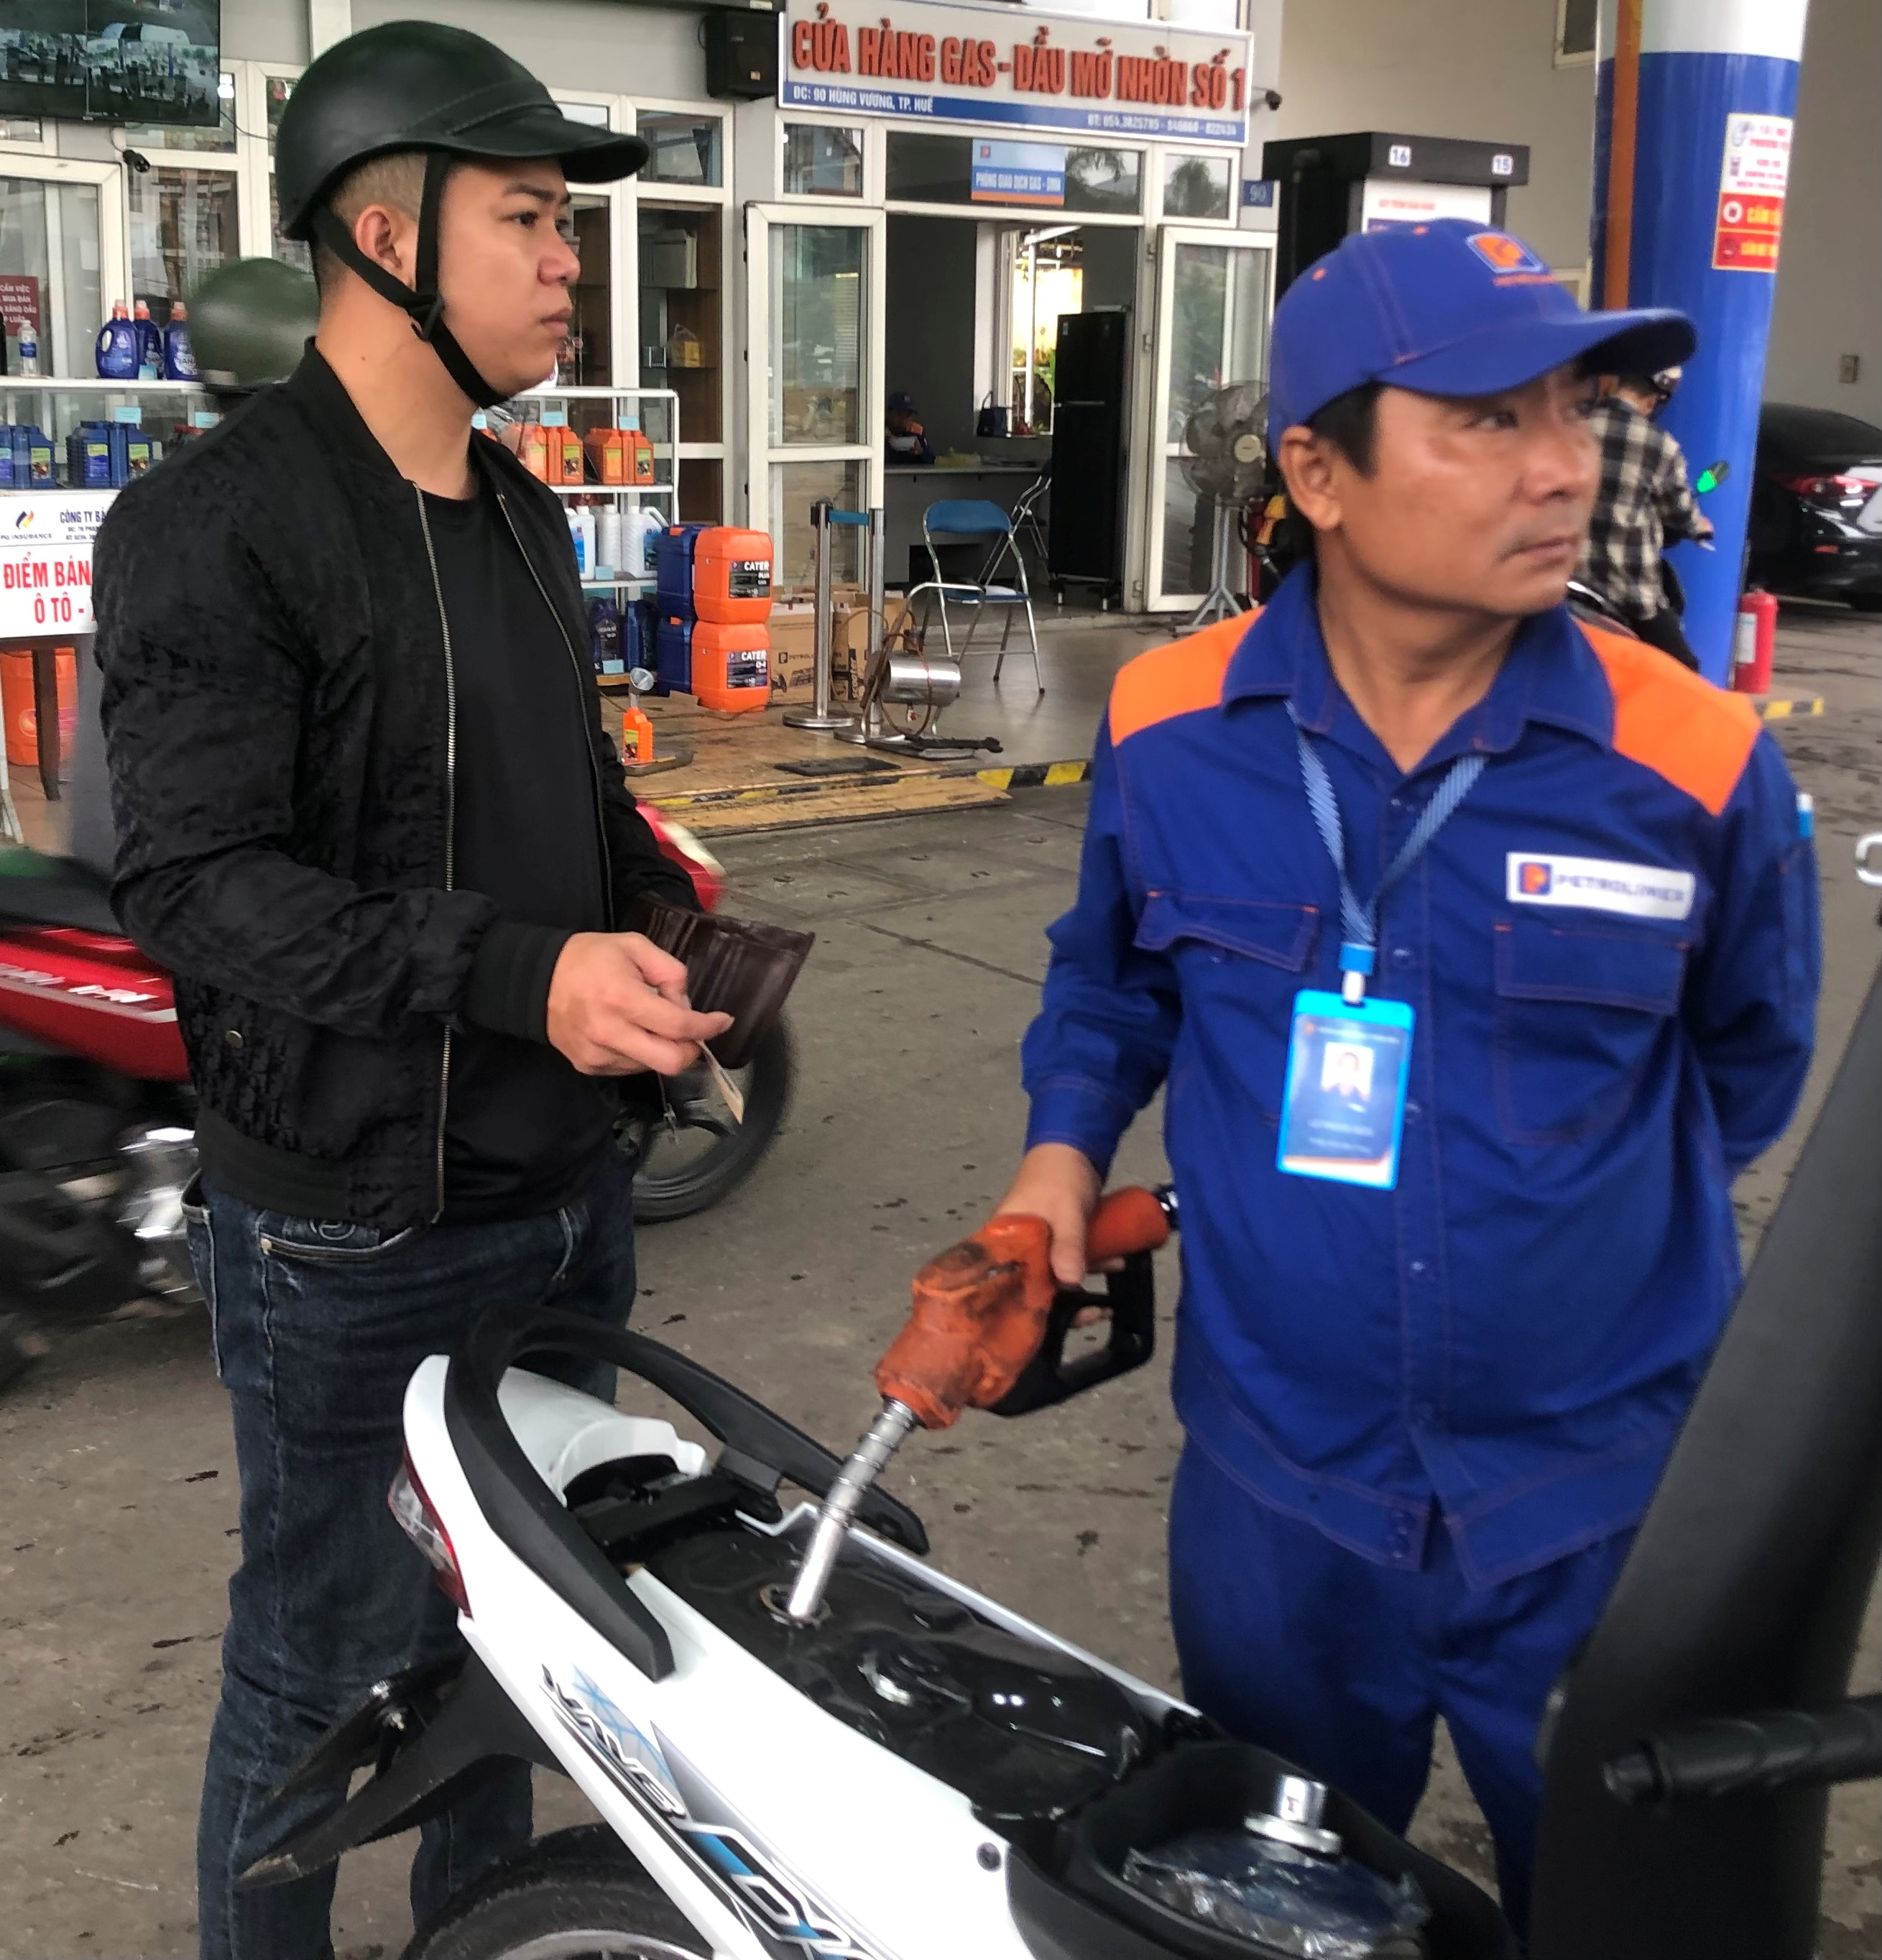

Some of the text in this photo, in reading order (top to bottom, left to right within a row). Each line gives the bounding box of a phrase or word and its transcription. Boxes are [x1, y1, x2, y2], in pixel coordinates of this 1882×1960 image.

[792, 2, 851, 73] CỬA
[858, 17, 935, 81] HÀNG
[1071, 37, 1113, 98] MỠ
[1116, 45, 1188, 106] NHỜN
[1192, 47, 1231, 109] SỐ
[1230, 68, 1245, 111] 1
[813, 86, 826, 101] 90
[829, 87, 857, 105] HÙNG
[898, 96, 912, 111] TP.
[914, 93, 933, 113] HUẾ
[1392, 147, 1408, 164] 16
[1496, 156, 1510, 171] 15
[60, 509, 81, 523] CÔNG
[84, 510, 92, 523] TY
[4, 551, 92, 589] ĐIỂM BÁN
[744, 561, 769, 571] CATER
[34, 592, 45, 624] Ô
[50, 591, 71, 623] TÔ
[741, 650, 767, 661] CATER
